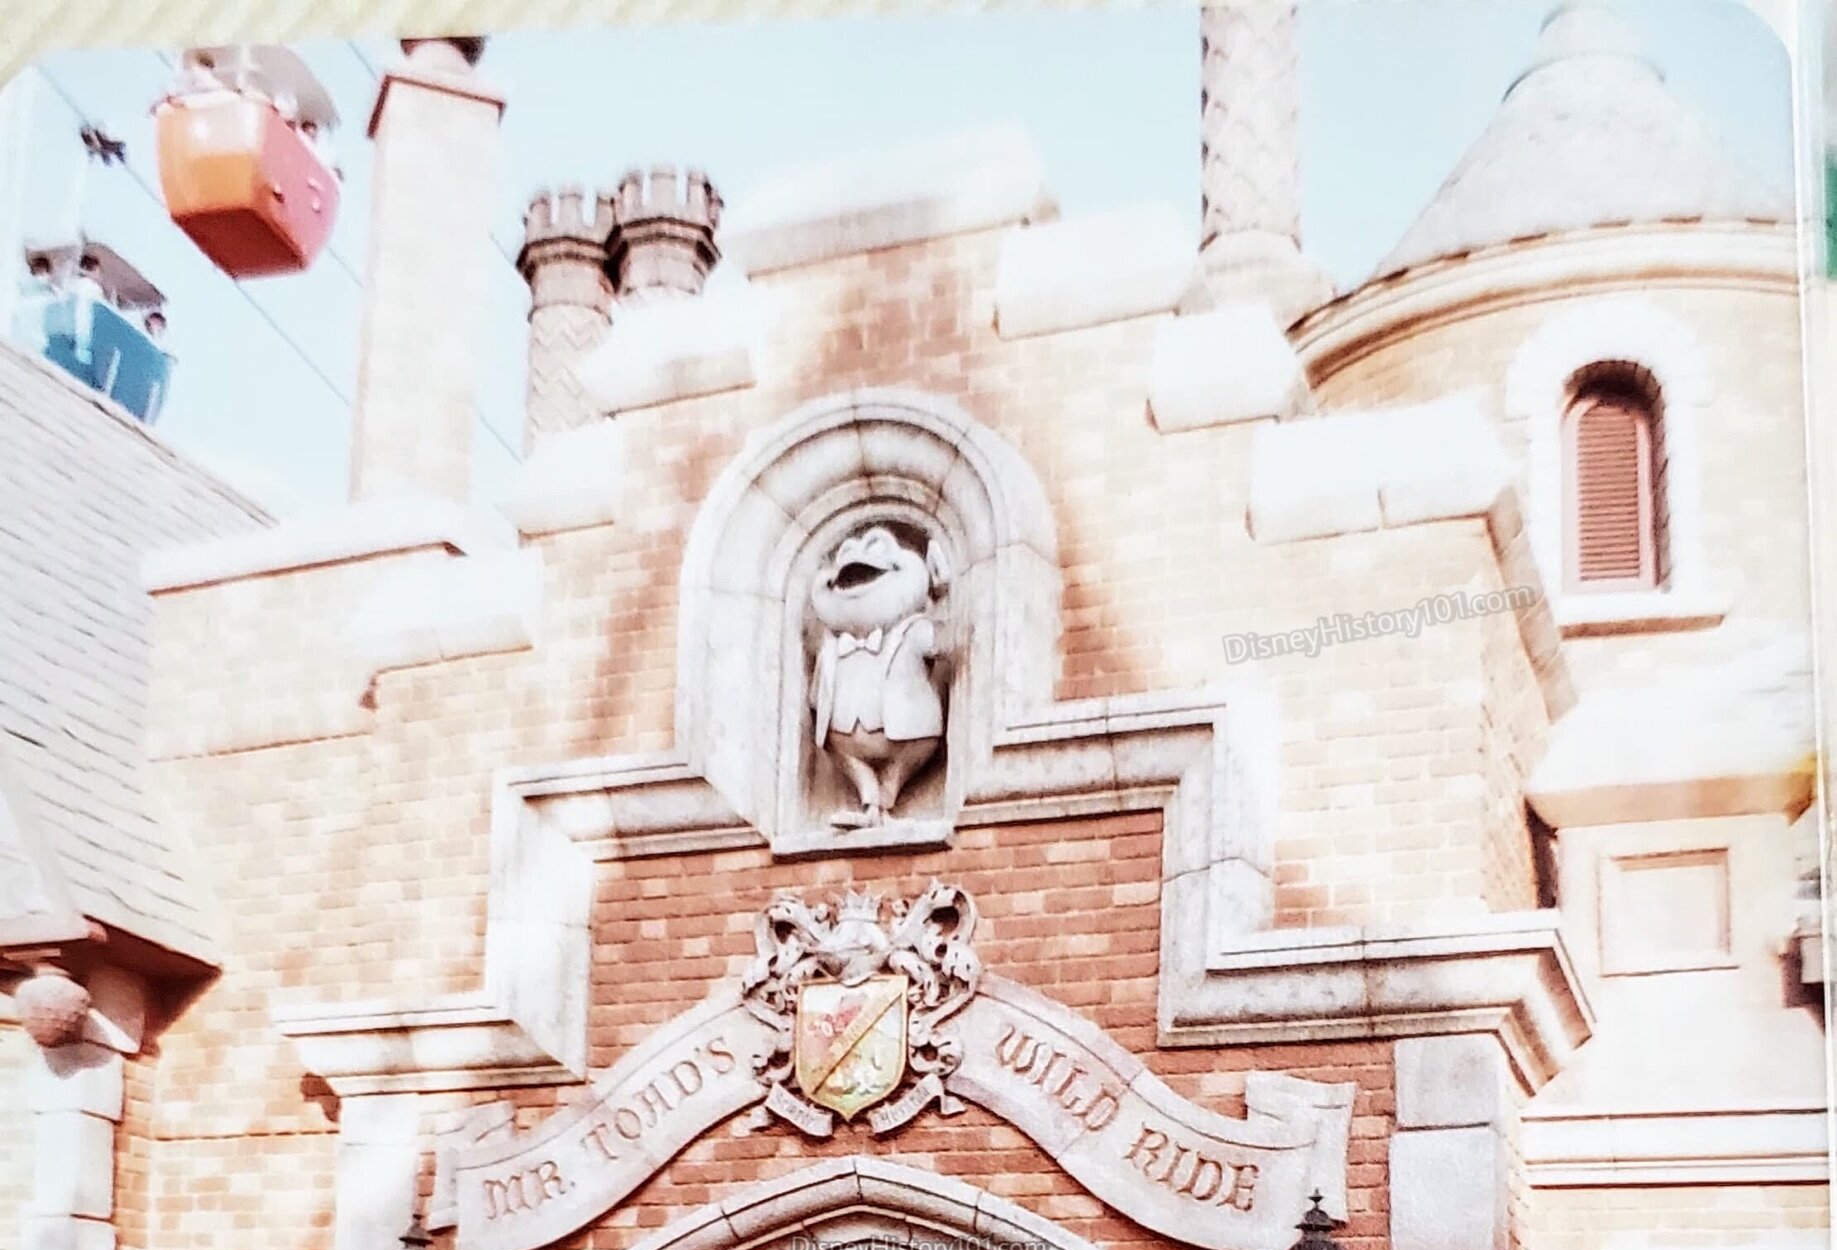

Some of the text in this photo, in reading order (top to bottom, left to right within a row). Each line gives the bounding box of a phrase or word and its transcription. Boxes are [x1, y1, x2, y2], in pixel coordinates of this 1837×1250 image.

[483, 1160, 576, 1221] MR.
[580, 1036, 735, 1160] TOAD'S
[995, 1022, 1120, 1132] WILD
[1121, 1120, 1259, 1212] RIDE
